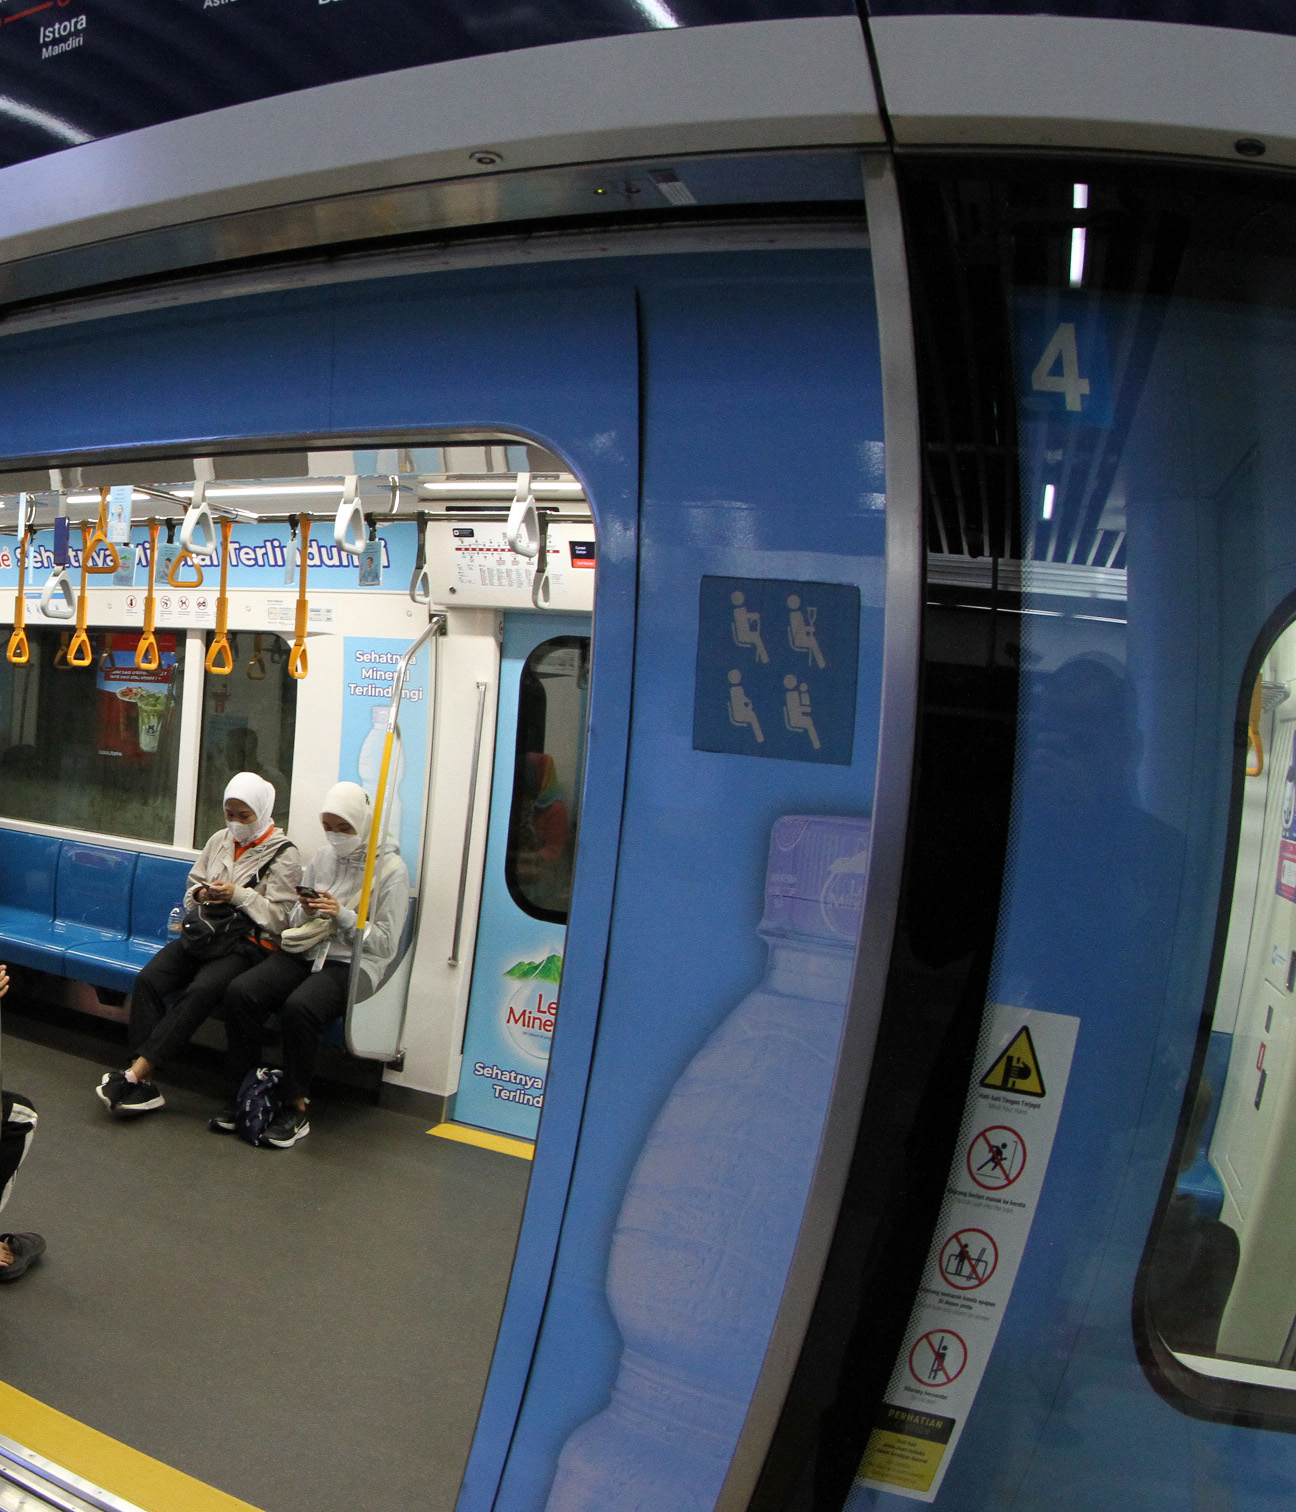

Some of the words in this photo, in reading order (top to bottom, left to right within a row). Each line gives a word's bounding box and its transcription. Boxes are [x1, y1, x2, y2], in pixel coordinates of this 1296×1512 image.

[39, 14, 87, 44] Istora
[42, 34, 84, 60] Mandiri
[1032, 323, 1090, 411] 4
[15, 545, 115, 569] Sehtnya
[227, 538, 390, 568] Terliduni
[355, 650, 417, 665] Sehatna
[361, 667, 410, 682] Minerl
[348, 683, 423, 702] Terlindngi
[537, 993, 558, 1016] Le
[474, 1062, 544, 1090] Sehatnya
[887, 1409, 943, 1429] PERHATIAN
